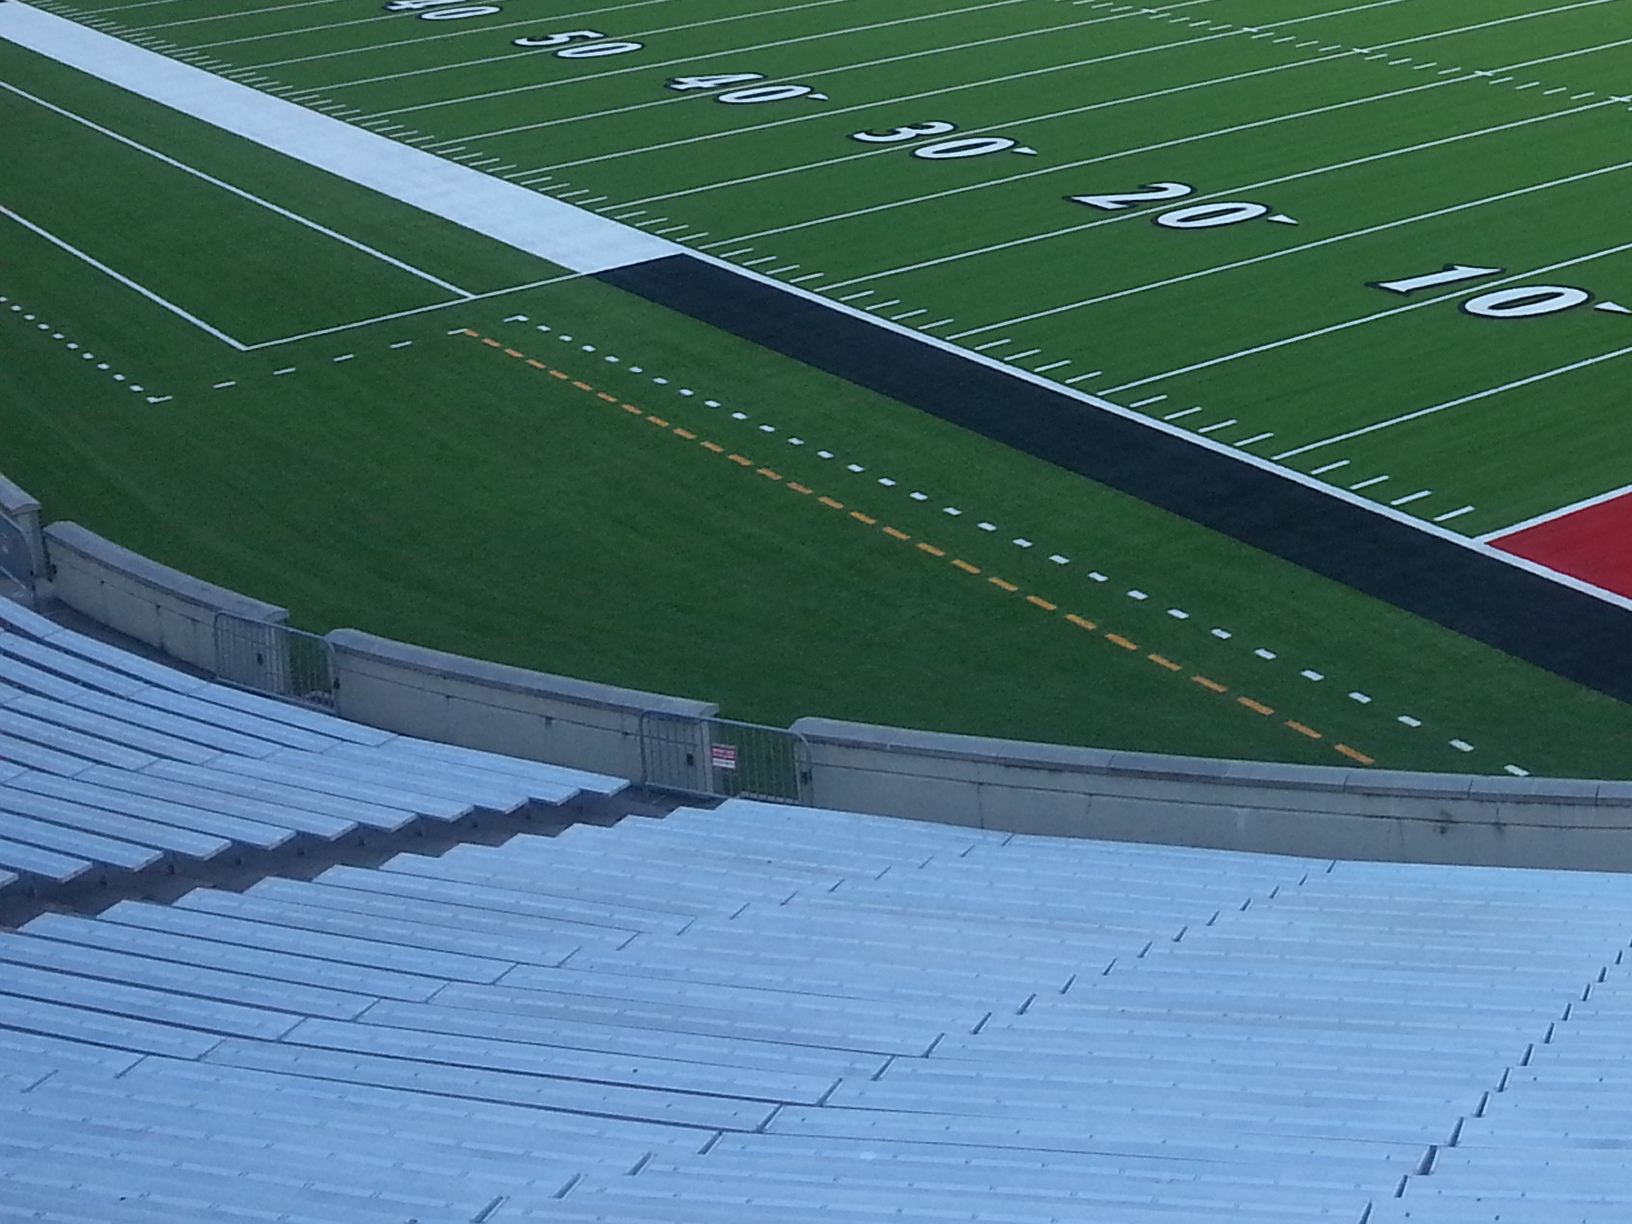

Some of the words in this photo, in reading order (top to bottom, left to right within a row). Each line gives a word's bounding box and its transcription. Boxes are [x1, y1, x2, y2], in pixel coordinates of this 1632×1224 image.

[512, 29, 645, 61] 50
[666, 71, 813, 106] 40
[849, 119, 1019, 161] 30
[1064, 181, 1273, 229] 20
[1368, 263, 1595, 319] 10
